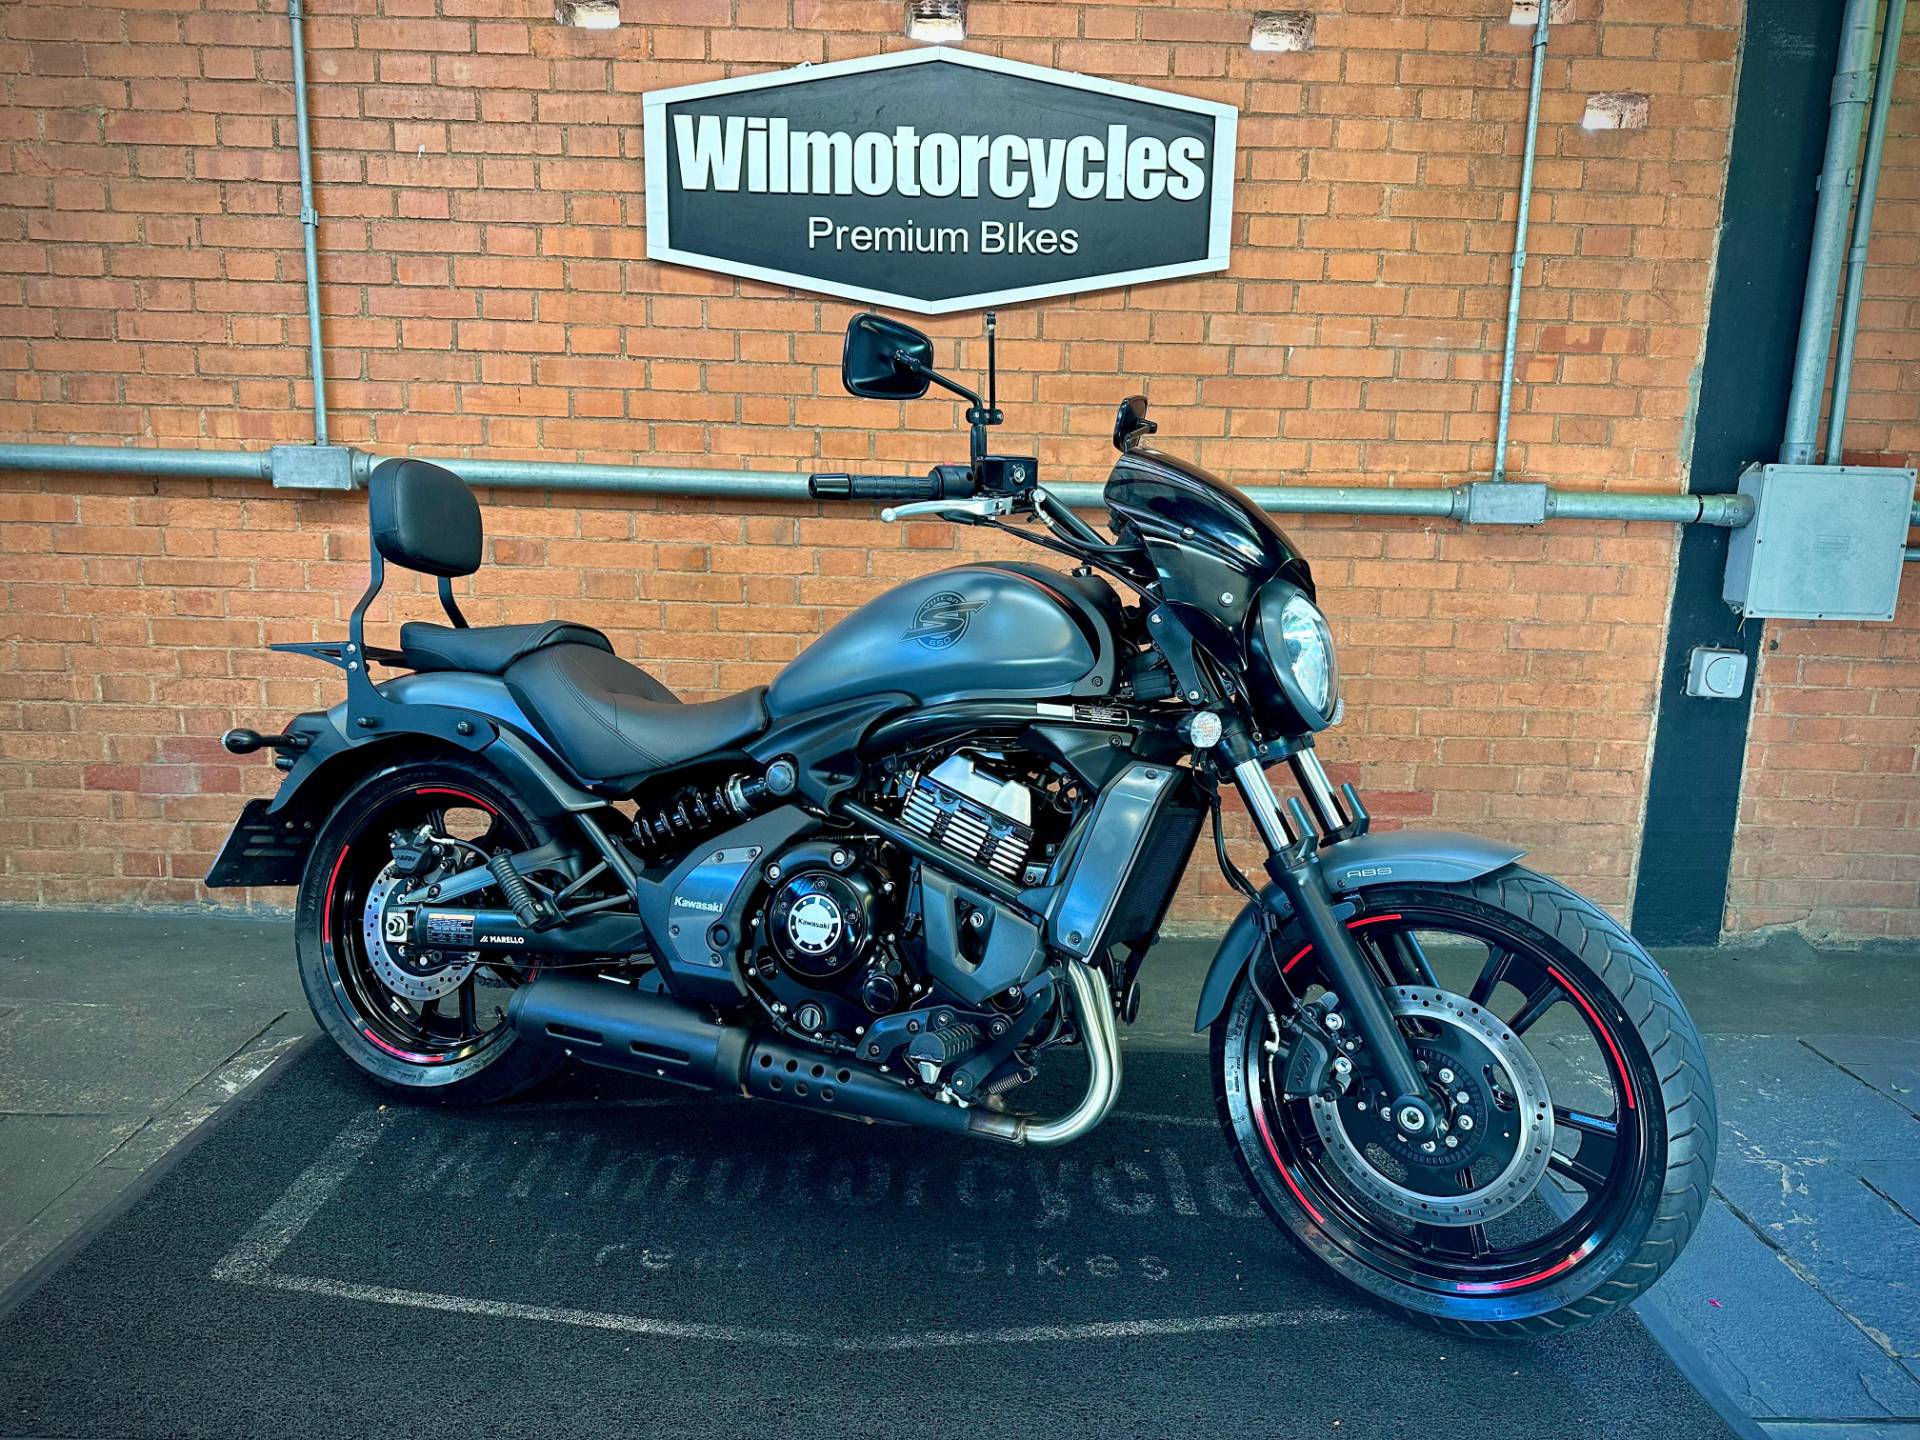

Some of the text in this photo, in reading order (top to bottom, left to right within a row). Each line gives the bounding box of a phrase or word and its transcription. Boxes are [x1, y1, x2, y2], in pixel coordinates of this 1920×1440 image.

[673, 114, 1206, 209] Wilmotorcycles
[807, 215, 970, 253] Premium
[928, 636, 952, 648] 650
[1346, 867, 1393, 878] ABS
[673, 895, 723, 913] Kawasaki
[797, 917, 831, 930] Kawasaki
[489, 935, 525, 945] MARELLO
